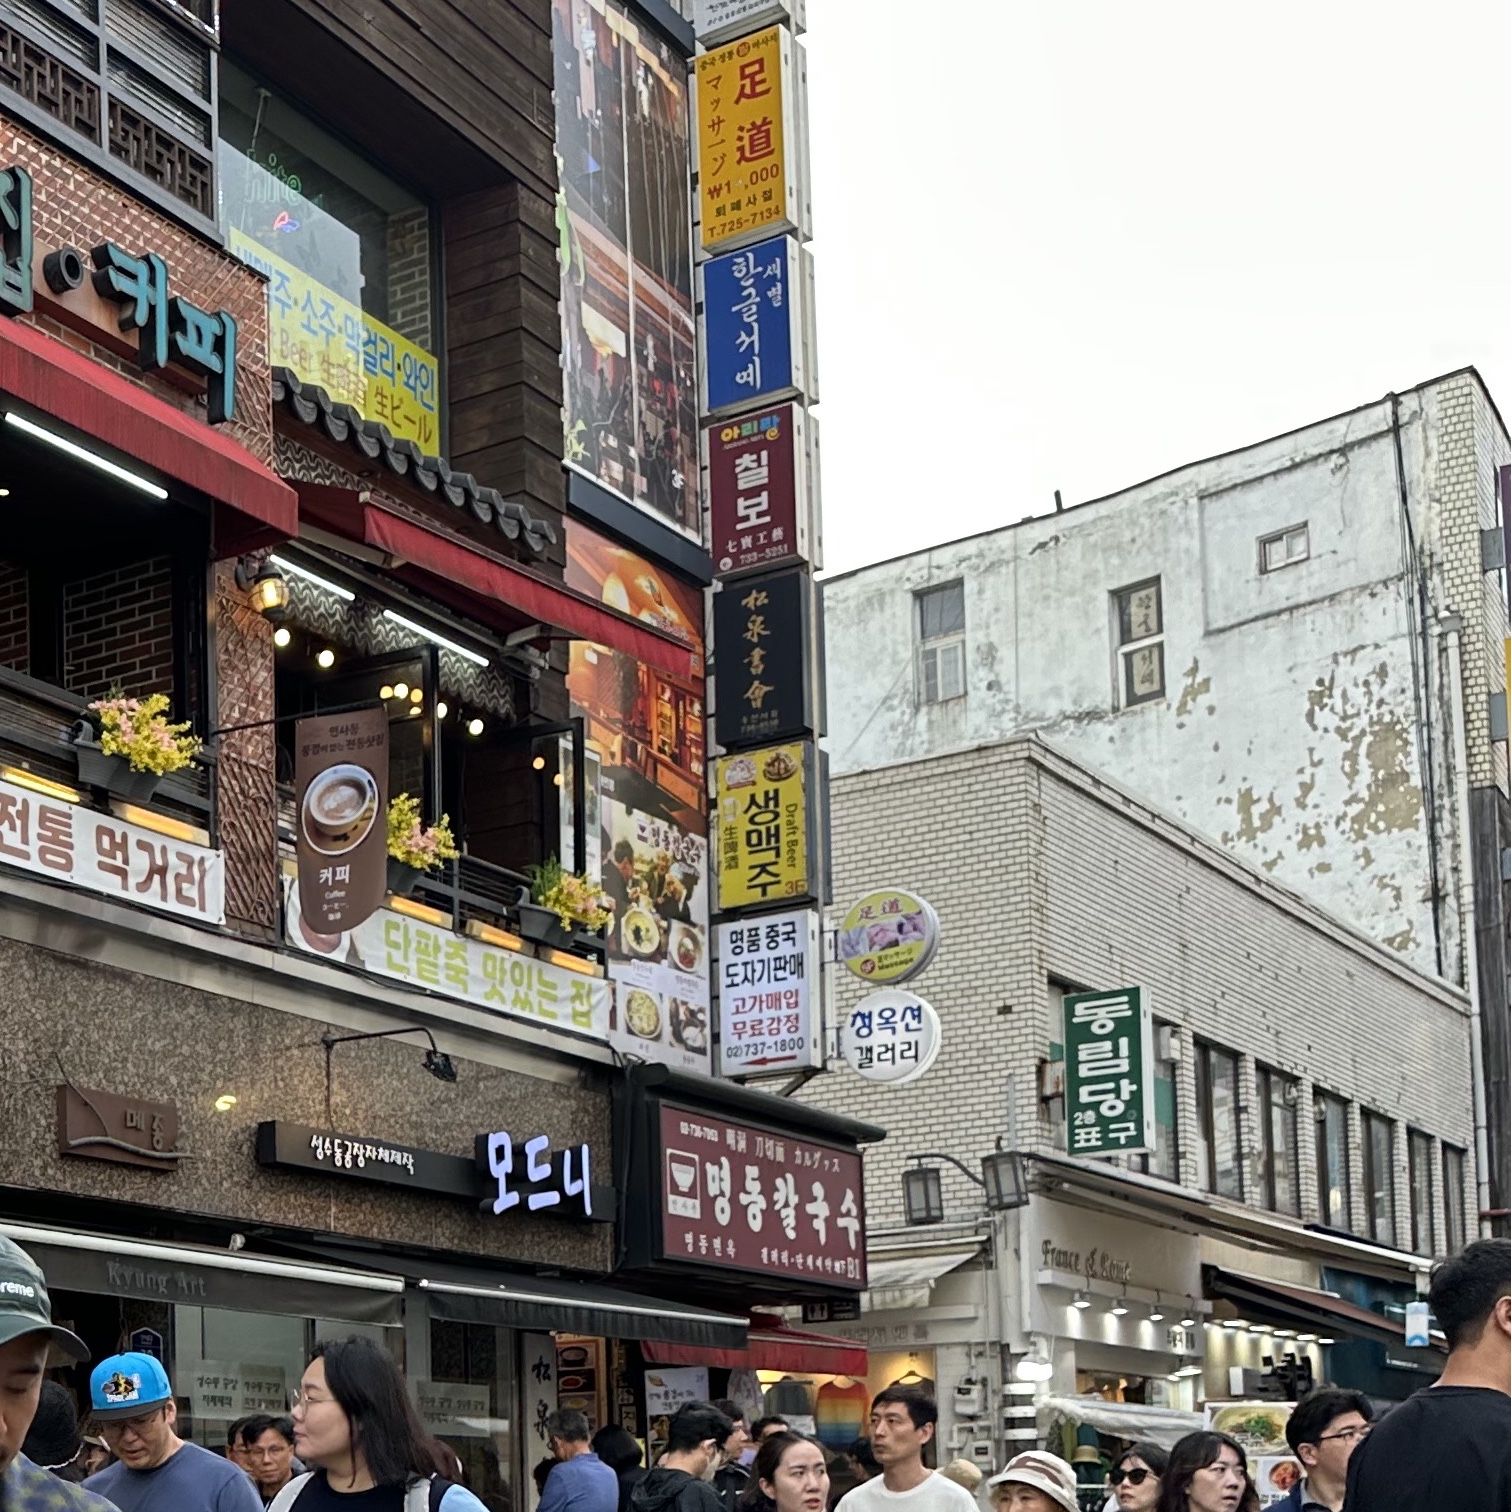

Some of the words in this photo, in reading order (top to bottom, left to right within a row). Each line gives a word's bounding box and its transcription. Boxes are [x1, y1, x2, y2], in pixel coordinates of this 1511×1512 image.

[706, 74, 727, 176] マッサージ
[734, 57, 775, 165] 足道
[708, 205, 781, 238] T.725-7134
[92, 242, 238, 423] 커피
[731, 252, 763, 391] 한글서예
[375, 385, 431, 444] 生ビール
[720, 415, 781, 442] 아리랑
[734, 450, 771, 531] 칠보
[785, 803, 799, 837] Draft
[743, 787, 782, 897] 생맥주
[786, 840, 799, 868] Beer
[95, 824, 207, 913] 먹거리
[319, 864, 351, 887] 커피
[730, 926, 761, 956] 명품
[765, 921, 797, 951] 중국
[384, 919, 469, 995] 단팥죽
[481, 951, 558, 1020] 맛있는
[571, 979, 592, 1029] 집
[725, 952, 804, 989] 도자기판매
[731, 988, 800, 1016] 고가매입
[731, 1013, 800, 1041] 무료감정
[726, 1036, 805, 1059] 02)737-1800
[854, 1040, 919, 1069] 갤러리
[1072, 996, 1137, 1117] 동림당
[1073, 1122, 1137, 1148] 표구
[488, 1131, 593, 1216] 모드니
[705, 1156, 860, 1251] 명동칼국수
[1042, 1239, 1080, 1272] France
[175, 1271, 206, 1297] Art
